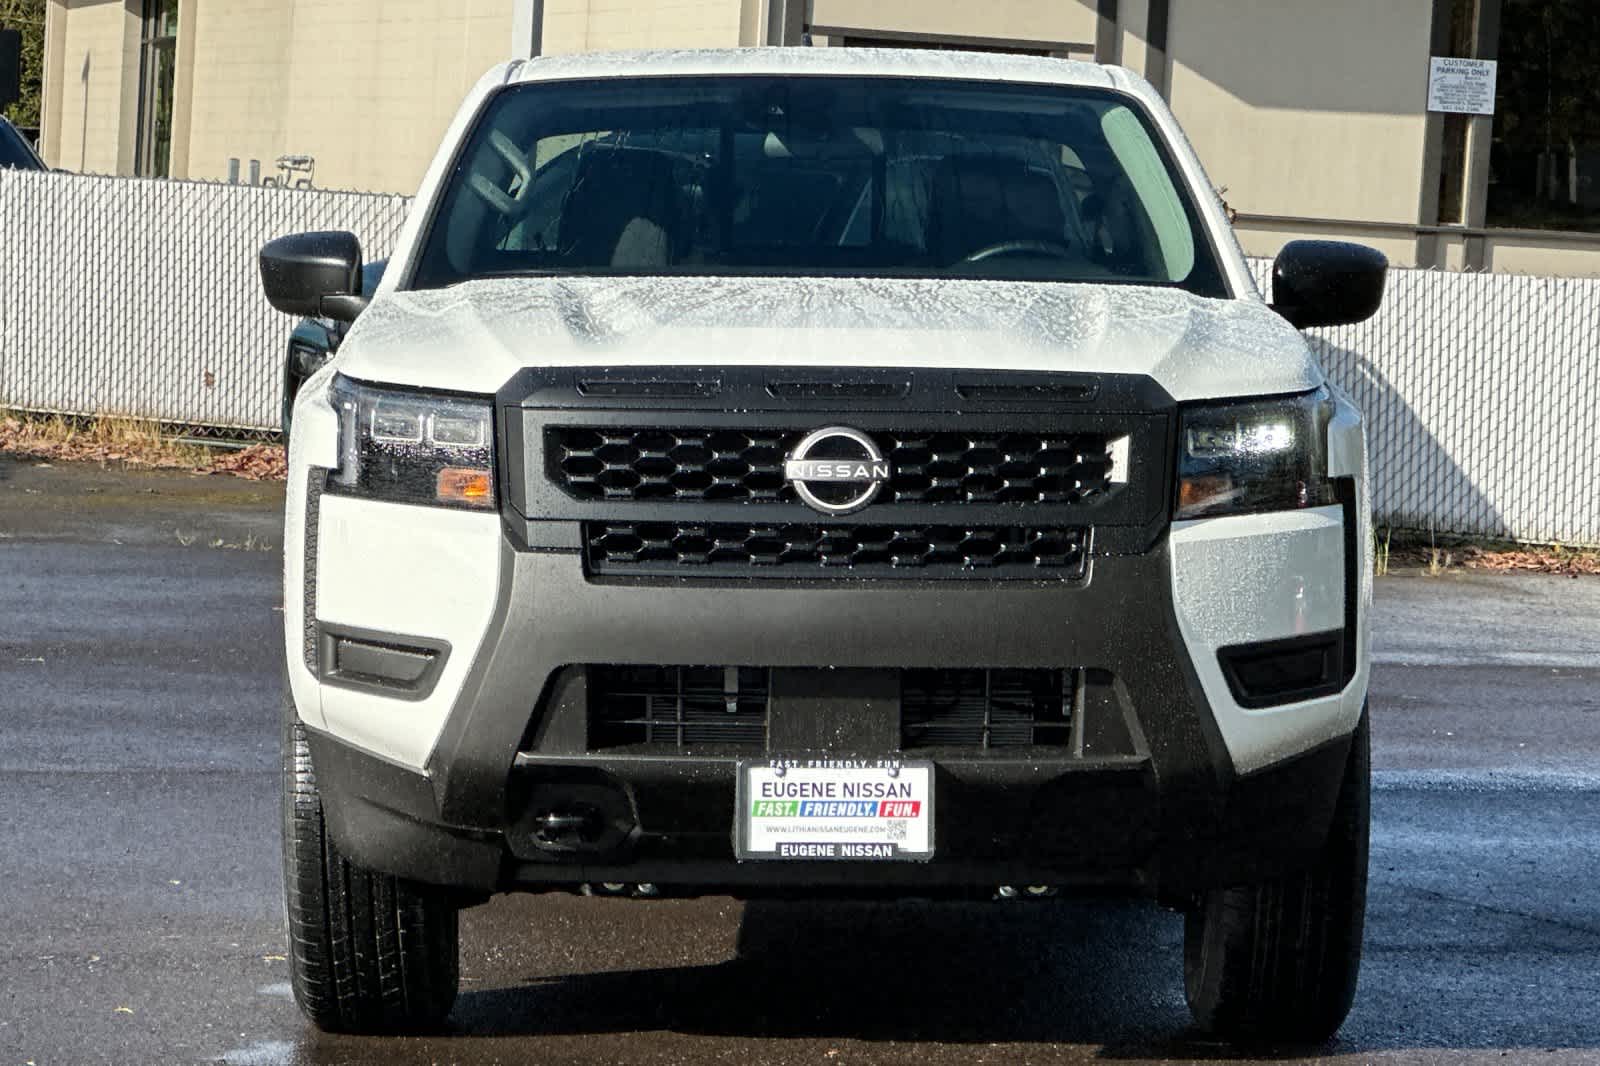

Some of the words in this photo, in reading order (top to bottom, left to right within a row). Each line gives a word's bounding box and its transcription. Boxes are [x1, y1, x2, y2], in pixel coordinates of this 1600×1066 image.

[1443, 59, 1485, 67] CUSTOMER
[1436, 66, 1470, 75] PARKING
[1471, 68, 1490, 77] ONLY
[787, 464, 889, 478] NISSAN
[762, 782, 836, 798] EUGENE
[843, 782, 912, 798] NISSAN
[756, 802, 796, 817] FAST.
[803, 802, 875, 817] FRIENDLY.
[883, 802, 918, 817] FUN.
[780, 844, 836, 857] EUGENE
[841, 844, 893, 857] NISSAN
